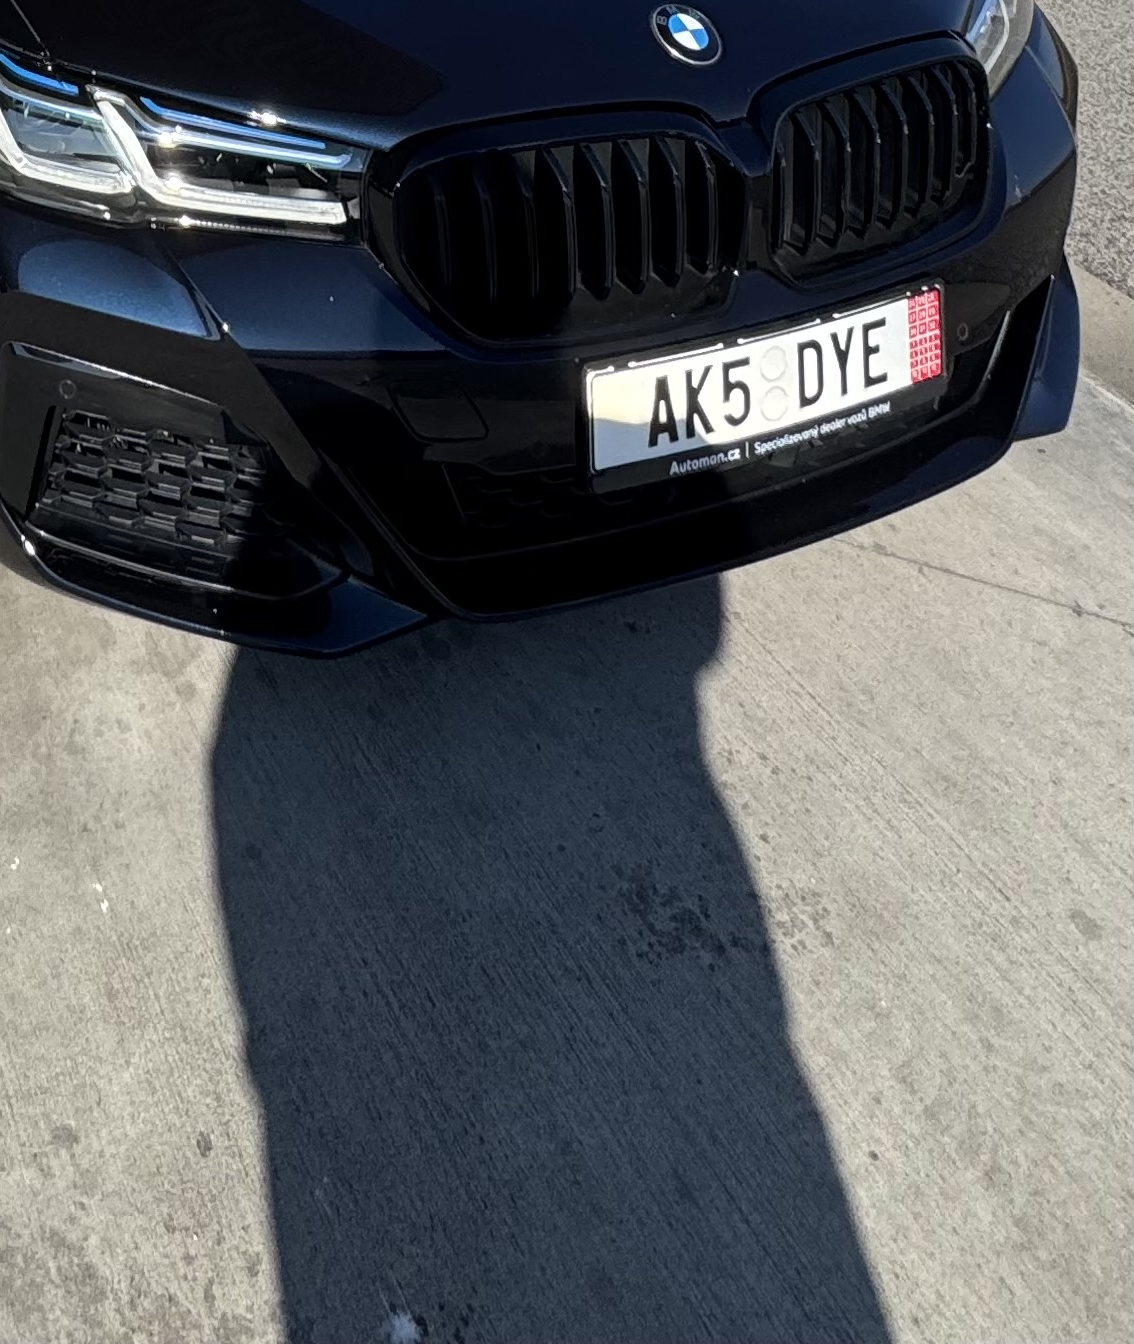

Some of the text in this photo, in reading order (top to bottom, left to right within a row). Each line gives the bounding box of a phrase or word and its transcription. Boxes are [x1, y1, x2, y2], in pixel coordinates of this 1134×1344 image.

[647, 356, 752, 448] AK5
[797, 316, 889, 409] DYE
[669, 448, 741, 476] Automan.cz
[819, 417, 847, 434] dealer
[868, 400, 891, 419] BMW
